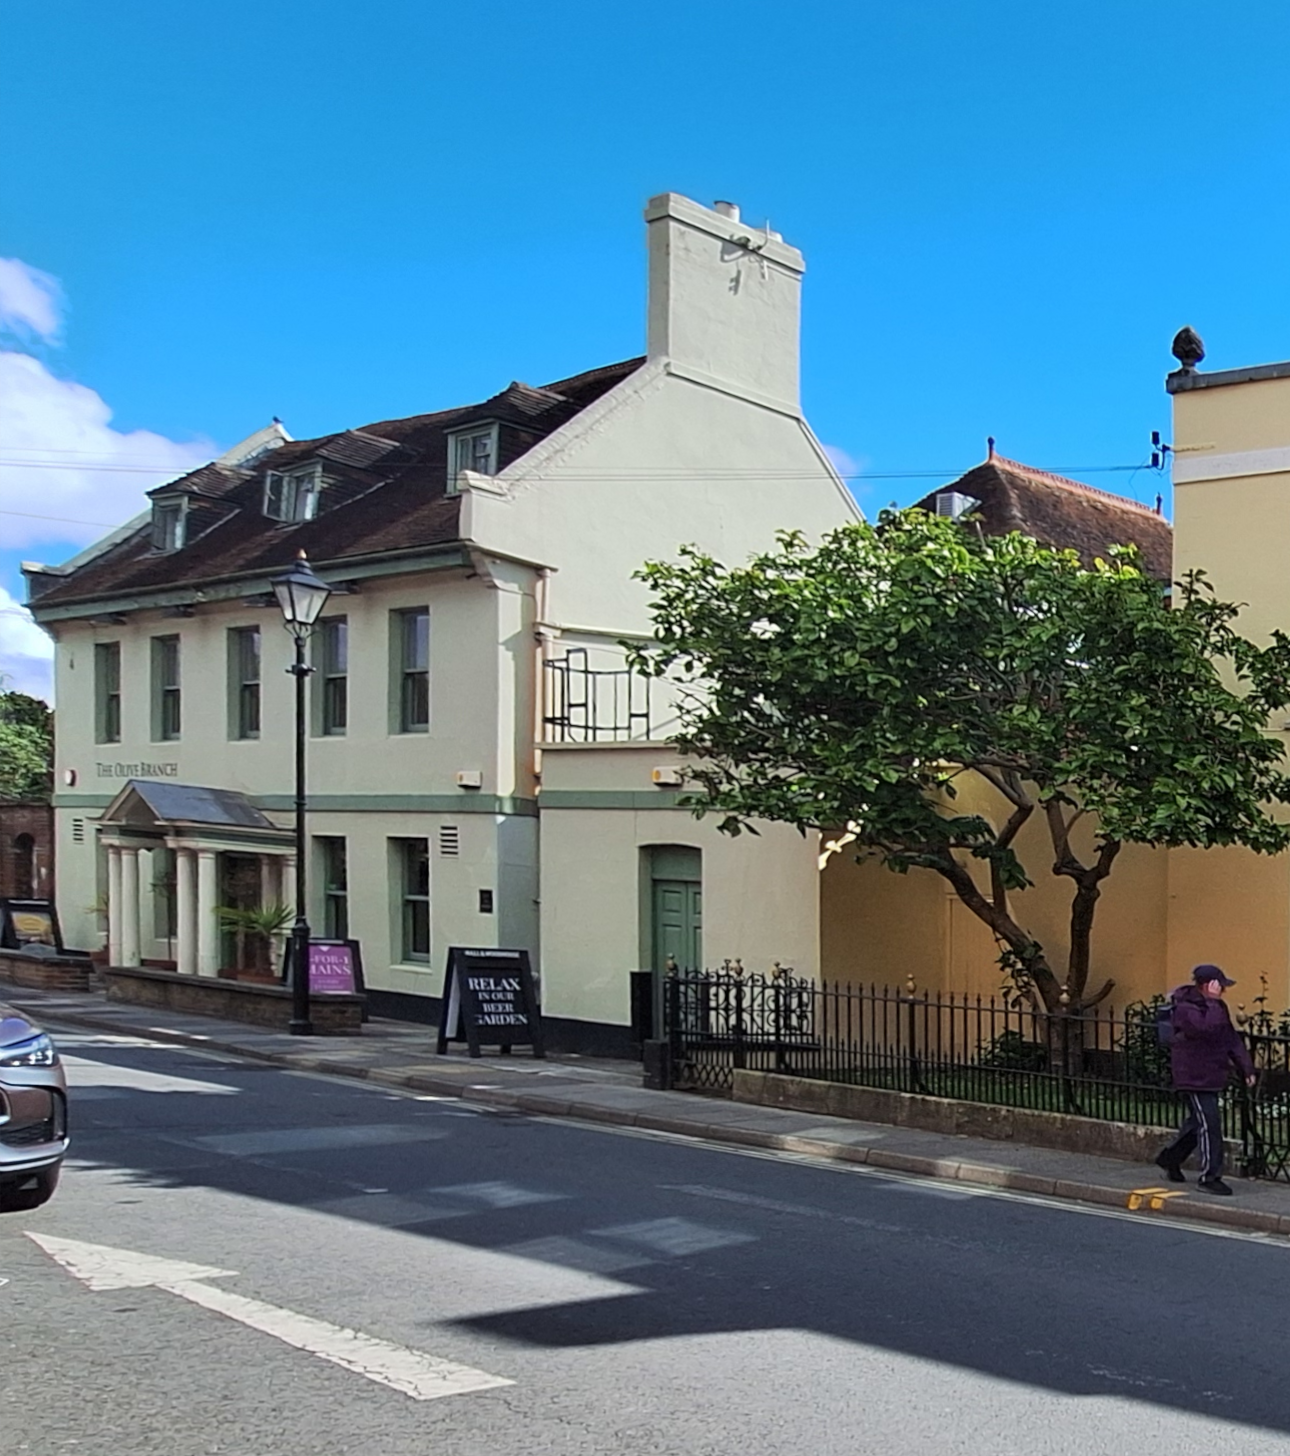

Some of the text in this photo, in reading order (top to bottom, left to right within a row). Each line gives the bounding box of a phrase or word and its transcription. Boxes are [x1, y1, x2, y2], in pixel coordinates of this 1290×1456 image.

[96, 762, 178, 777] THE OLIVE BRANCH
[468, 977, 521, 991] RELAX
[478, 991, 515, 1001] IN OUR
[482, 1003, 514, 1013] BEER
